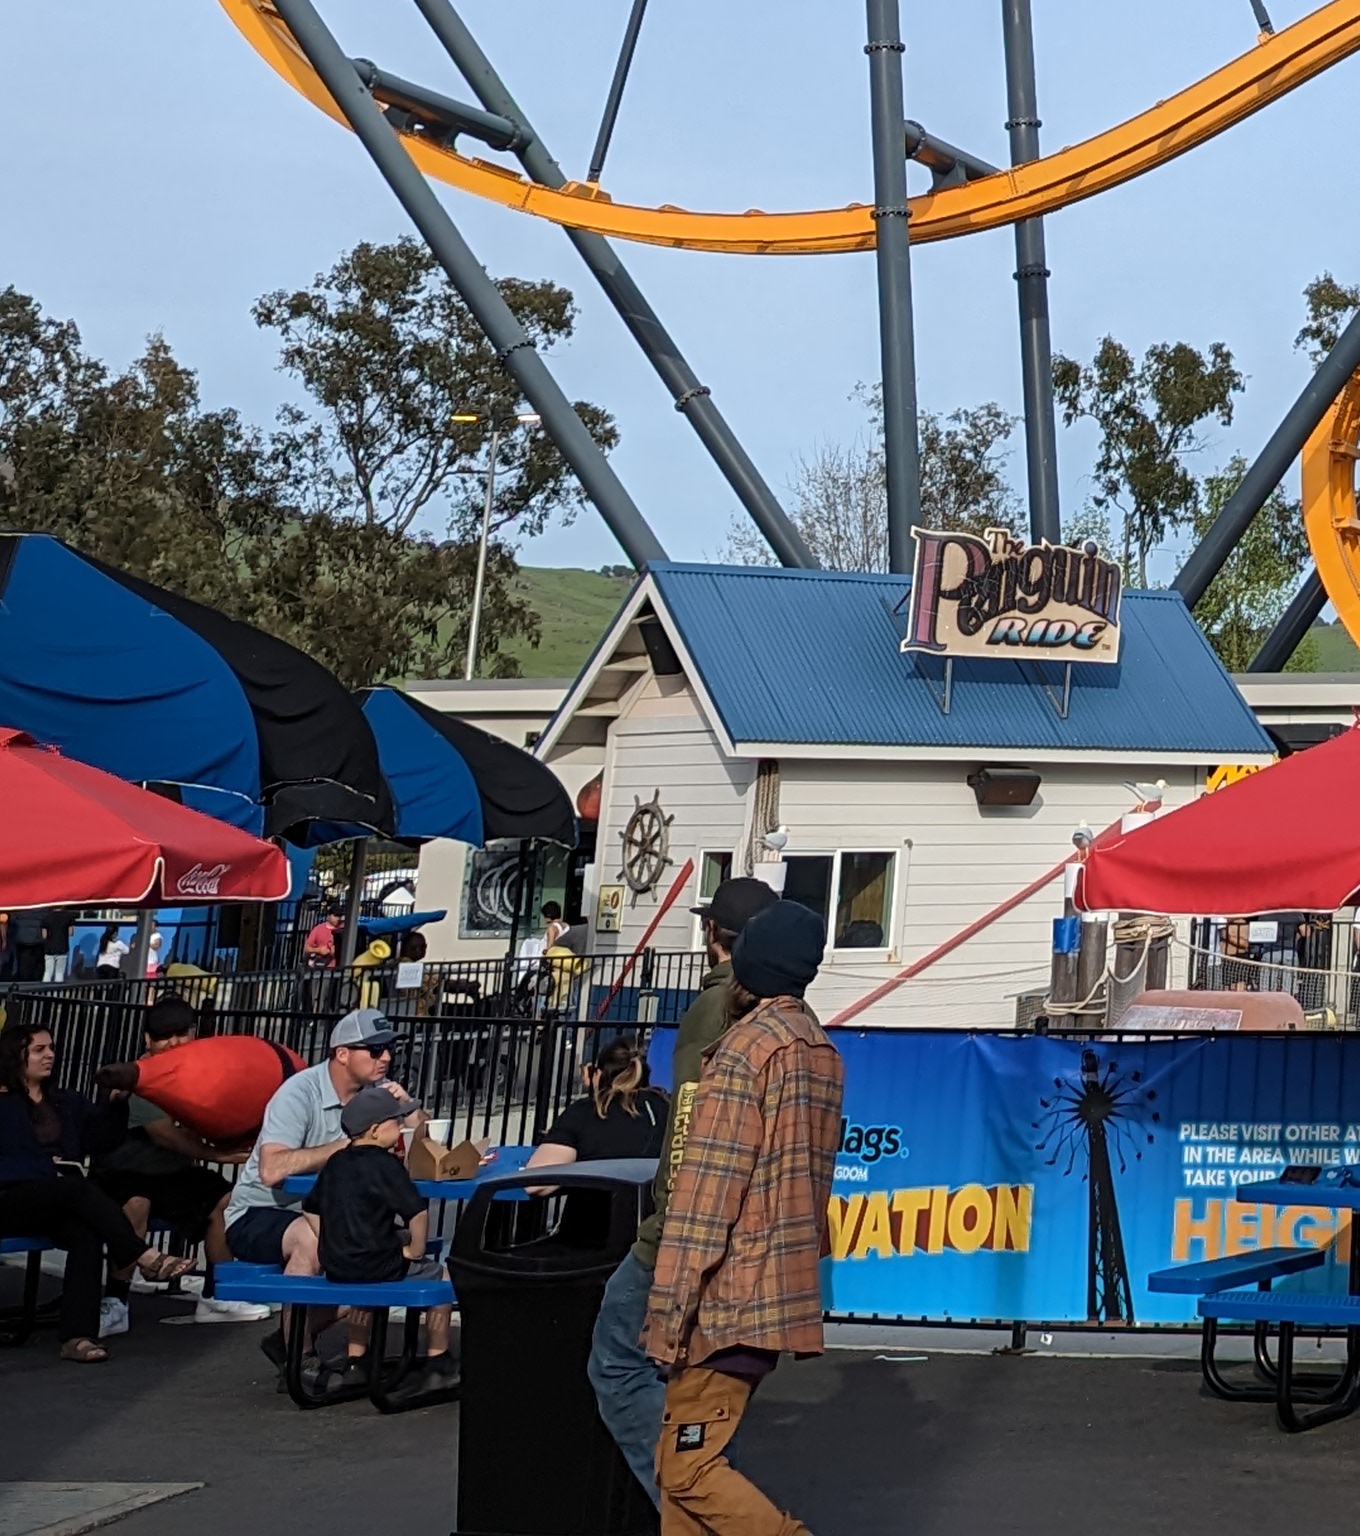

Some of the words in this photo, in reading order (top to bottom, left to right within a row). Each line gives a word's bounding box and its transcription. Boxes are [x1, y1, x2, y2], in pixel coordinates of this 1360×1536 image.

[988, 530, 1025, 555] The
[904, 529, 1118, 651] Penguin
[985, 616, 1109, 650] RIDE
[837, 1117, 901, 1162] lags
[1179, 1124, 1238, 1141] PLEASE
[1242, 1125, 1282, 1141] VISIT
[1285, 1125, 1338, 1141] OTHER
[1184, 1147, 1200, 1163] IN
[1206, 1147, 1235, 1163] THE
[1239, 1148, 1284, 1164] AREA
[1288, 1148, 1340, 1164] WHILE
[834, 1166, 868, 1181] GDOM
[1184, 1170, 1226, 1186] TAKE
[825, 1183, 1034, 1261] VATION
